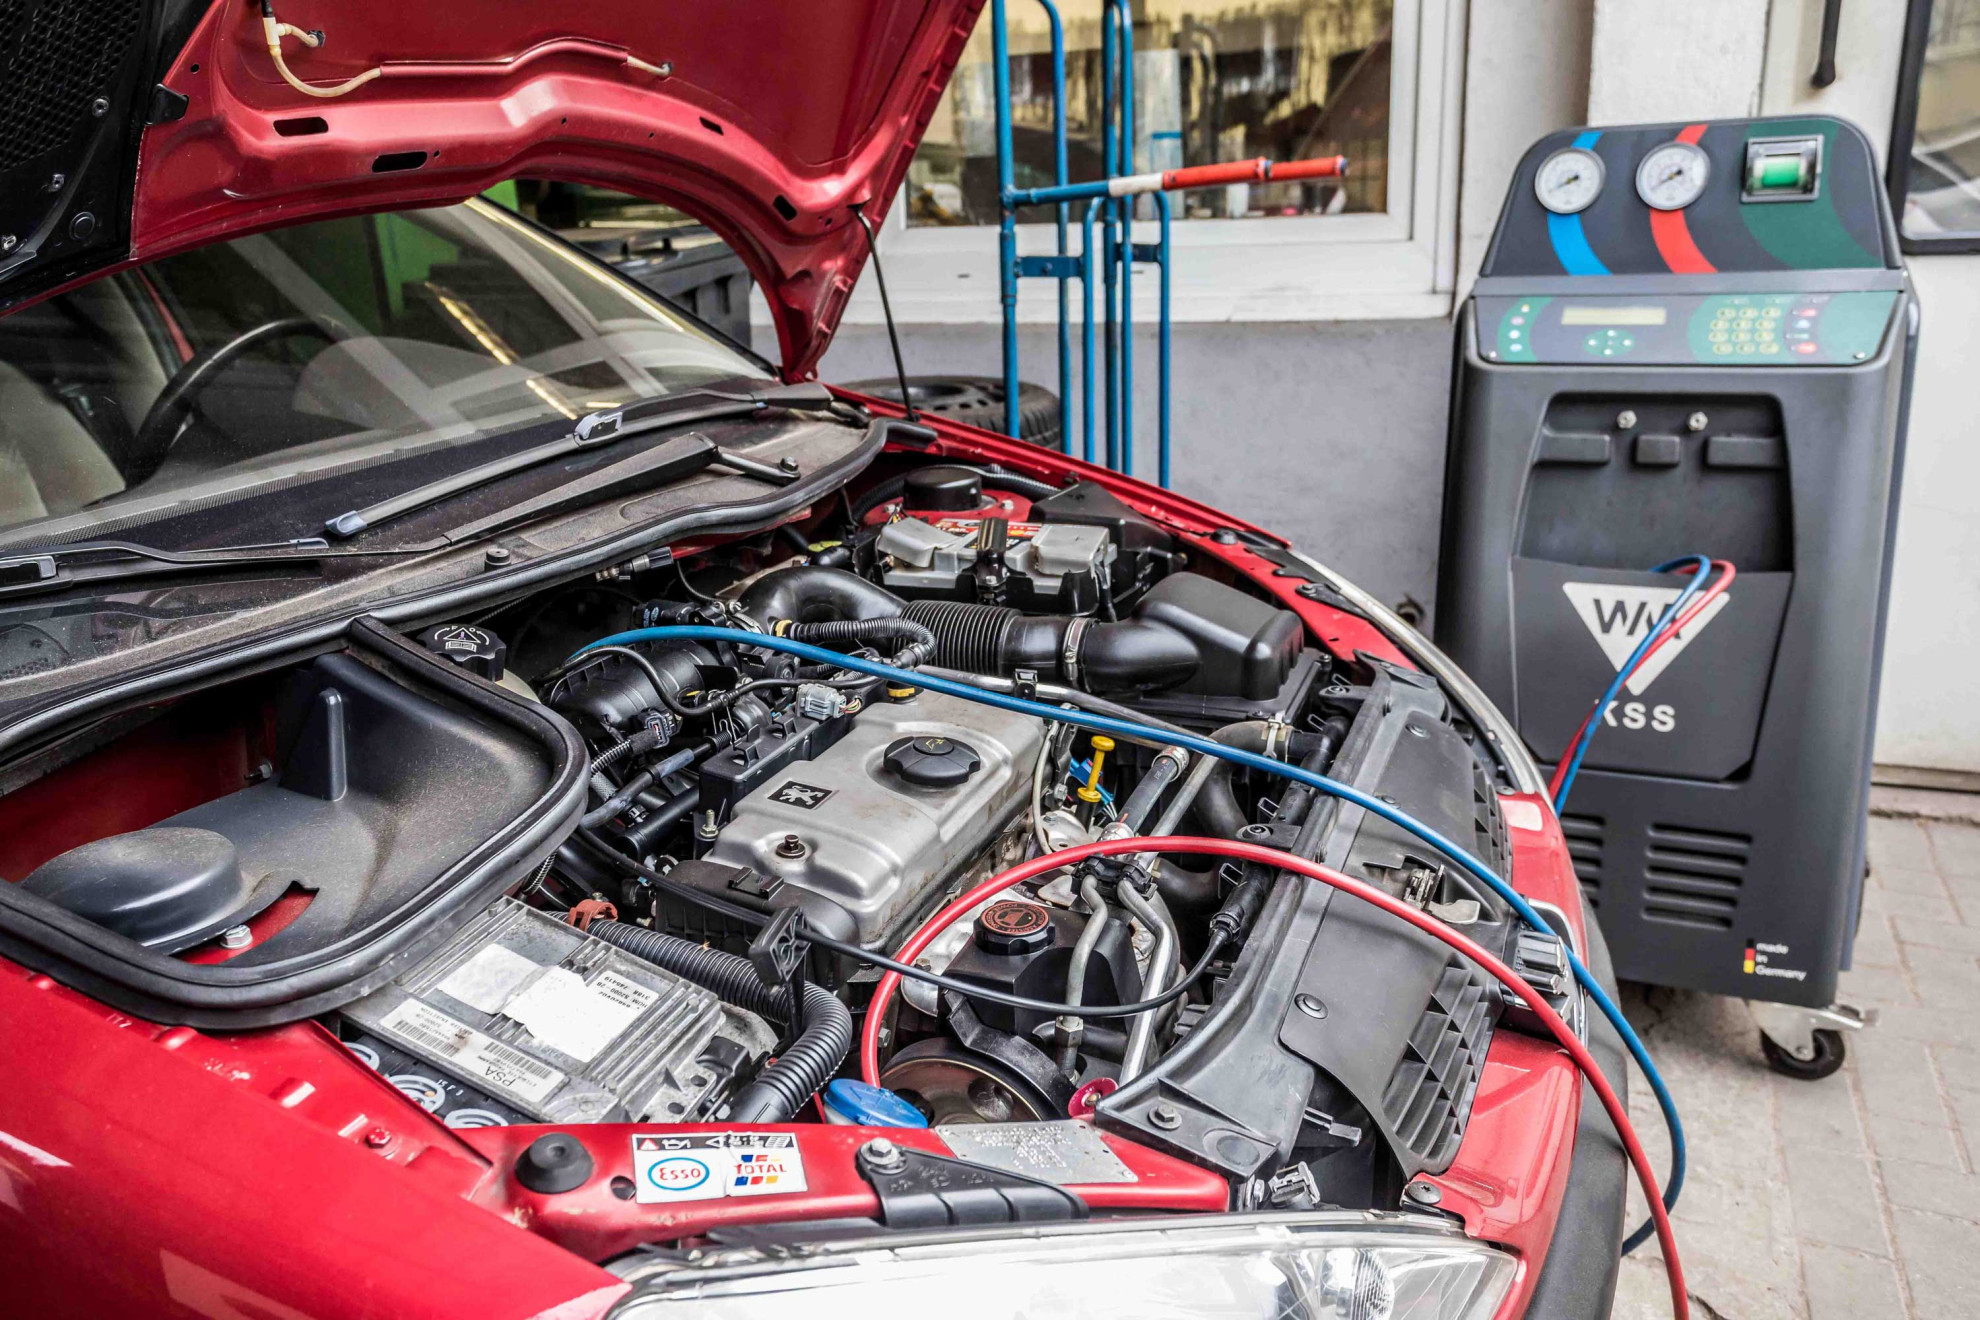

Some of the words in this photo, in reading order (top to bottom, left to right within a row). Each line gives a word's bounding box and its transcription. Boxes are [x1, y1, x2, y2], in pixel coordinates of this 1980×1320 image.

[1756, 942, 1789, 955] made
[1755, 953, 1768, 964] in
[1755, 964, 1807, 981] Germany
[485, 1065, 517, 1088] PSA
[733, 1163, 787, 1175] TOTAL
